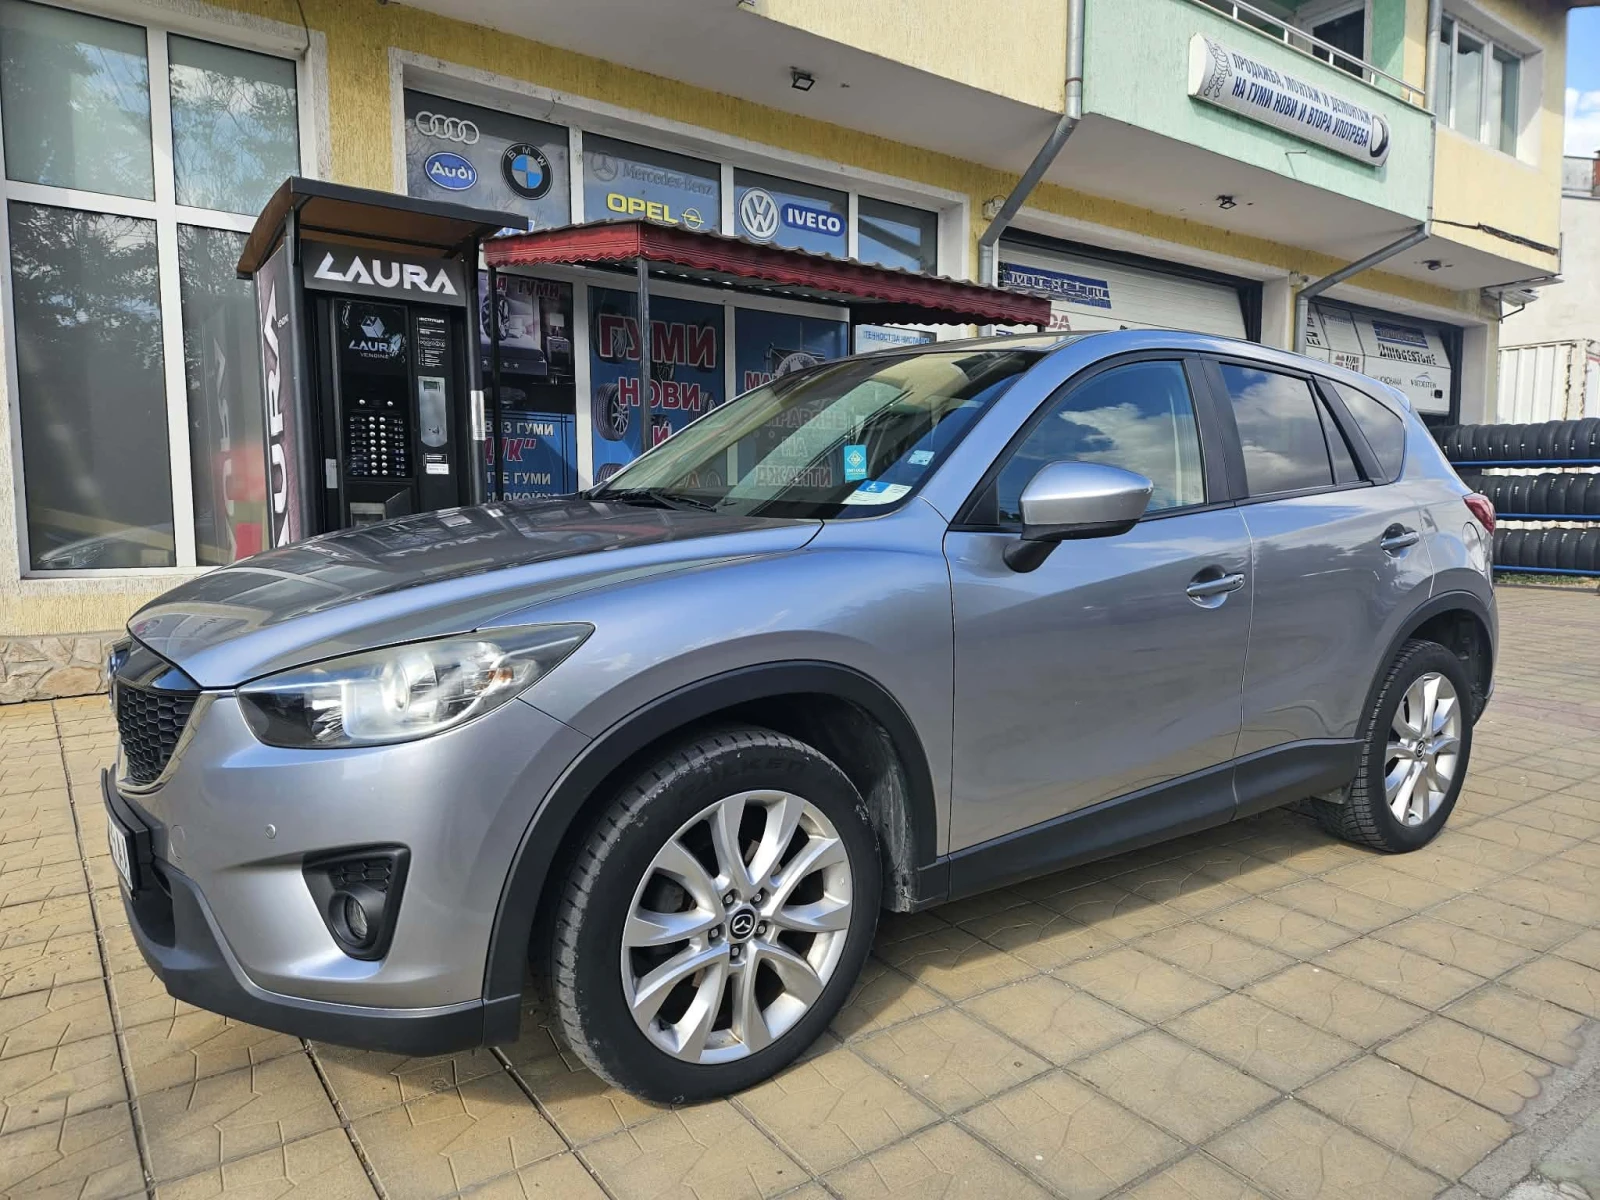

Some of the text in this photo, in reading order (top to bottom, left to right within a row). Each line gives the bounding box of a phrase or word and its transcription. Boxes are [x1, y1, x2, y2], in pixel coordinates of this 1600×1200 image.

[1232, 53, 1284, 89] ПРОДАЖБА,
[1284, 75, 1321, 104] МОНТАЖ
[1322, 92, 1330, 107] И
[1232, 76, 1369, 147] НА ГУМИ НОВИ И ВТОРА УПОТРЕБА
[431, 161, 473, 180] Audi
[507, 146, 547, 167] BMW
[622, 162, 713, 196] Mercedes-Benz
[607, 191, 679, 224] OPEL
[787, 207, 841, 232] IVECO
[313, 251, 459, 296] LAURA
[600, 313, 716, 368] ГУМИ
[618, 376, 700, 411] НОВИ
[516, 422, 554, 436] ГУМИ
[514, 472, 551, 485] ГУМИ
